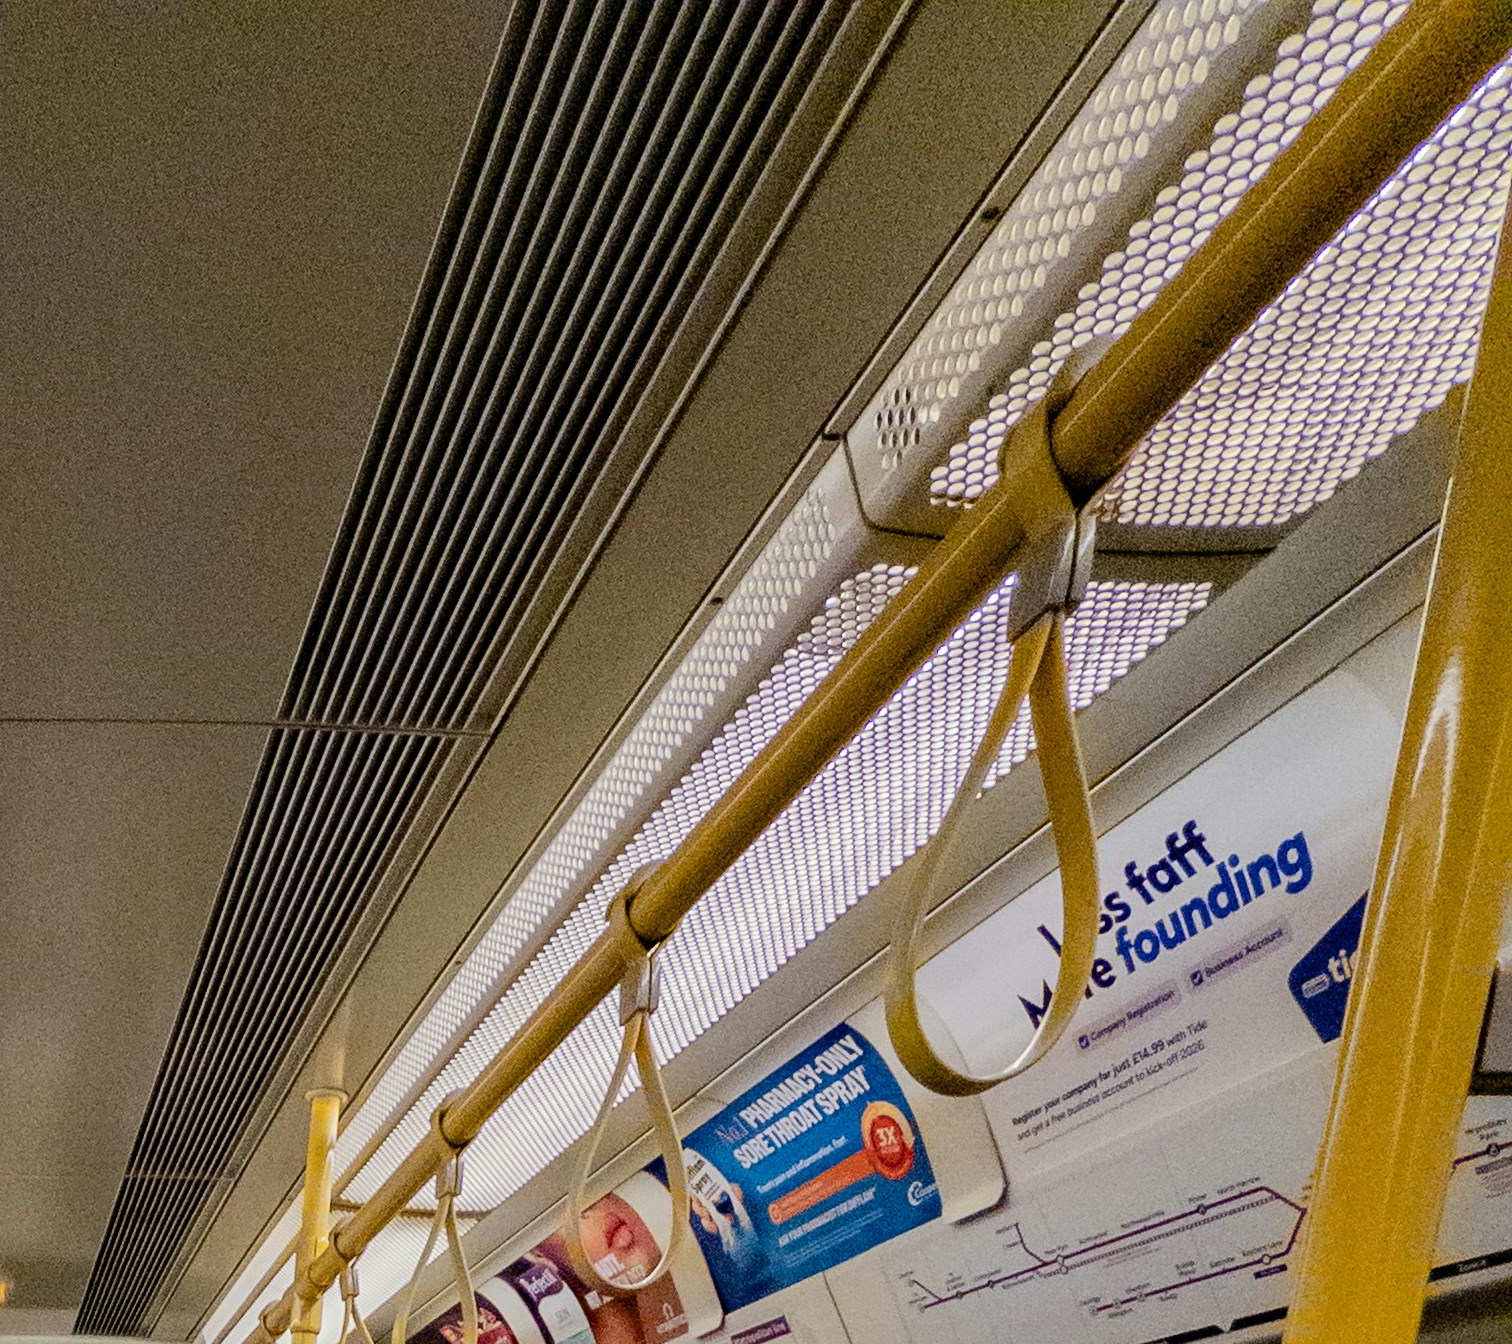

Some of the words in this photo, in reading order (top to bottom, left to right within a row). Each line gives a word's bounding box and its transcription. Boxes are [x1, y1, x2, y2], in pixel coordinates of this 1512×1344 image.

[1017, 957, 1117, 1031] Me
[1115, 830, 1314, 975] founding
[1037, 890, 1132, 957] Lss
[1124, 819, 1216, 906] faff
[1204, 950, 1244, 978] Business
[1244, 927, 1285, 956] Account
[1090, 1016, 1127, 1042] Company
[1126, 989, 1176, 1021] Registration
[733, 1133, 775, 1169] SORE
[763, 1100, 823, 1149] THROAT
[814, 1064, 871, 1116] SPRAY
[739, 1034, 864, 1129] PHARMACY-ONLY
[1012, 1106, 1043, 1127] Register
[1044, 1097, 1061, 1113] your
[1062, 1078, 1098, 1102] company
[1098, 1070, 1112, 1083] for
[1111, 1057, 1132, 1079] just
[1132, 1039, 1166, 1066] £14.99
[1166, 1030, 1187, 1047] with
[1186, 1018, 1209, 1037] Tide
[1017, 1129, 1032, 1142] and
[1032, 1123, 1044, 1138] get
[1051, 1110, 1067, 1125] free
[1067, 1093, 1101, 1118] business
[1102, 1075, 1136, 1100] account
[1135, 1070, 1145, 1082] to
[1145, 1053, 1180, 1077] kick-off
[876, 1125, 897, 1147] 3X
